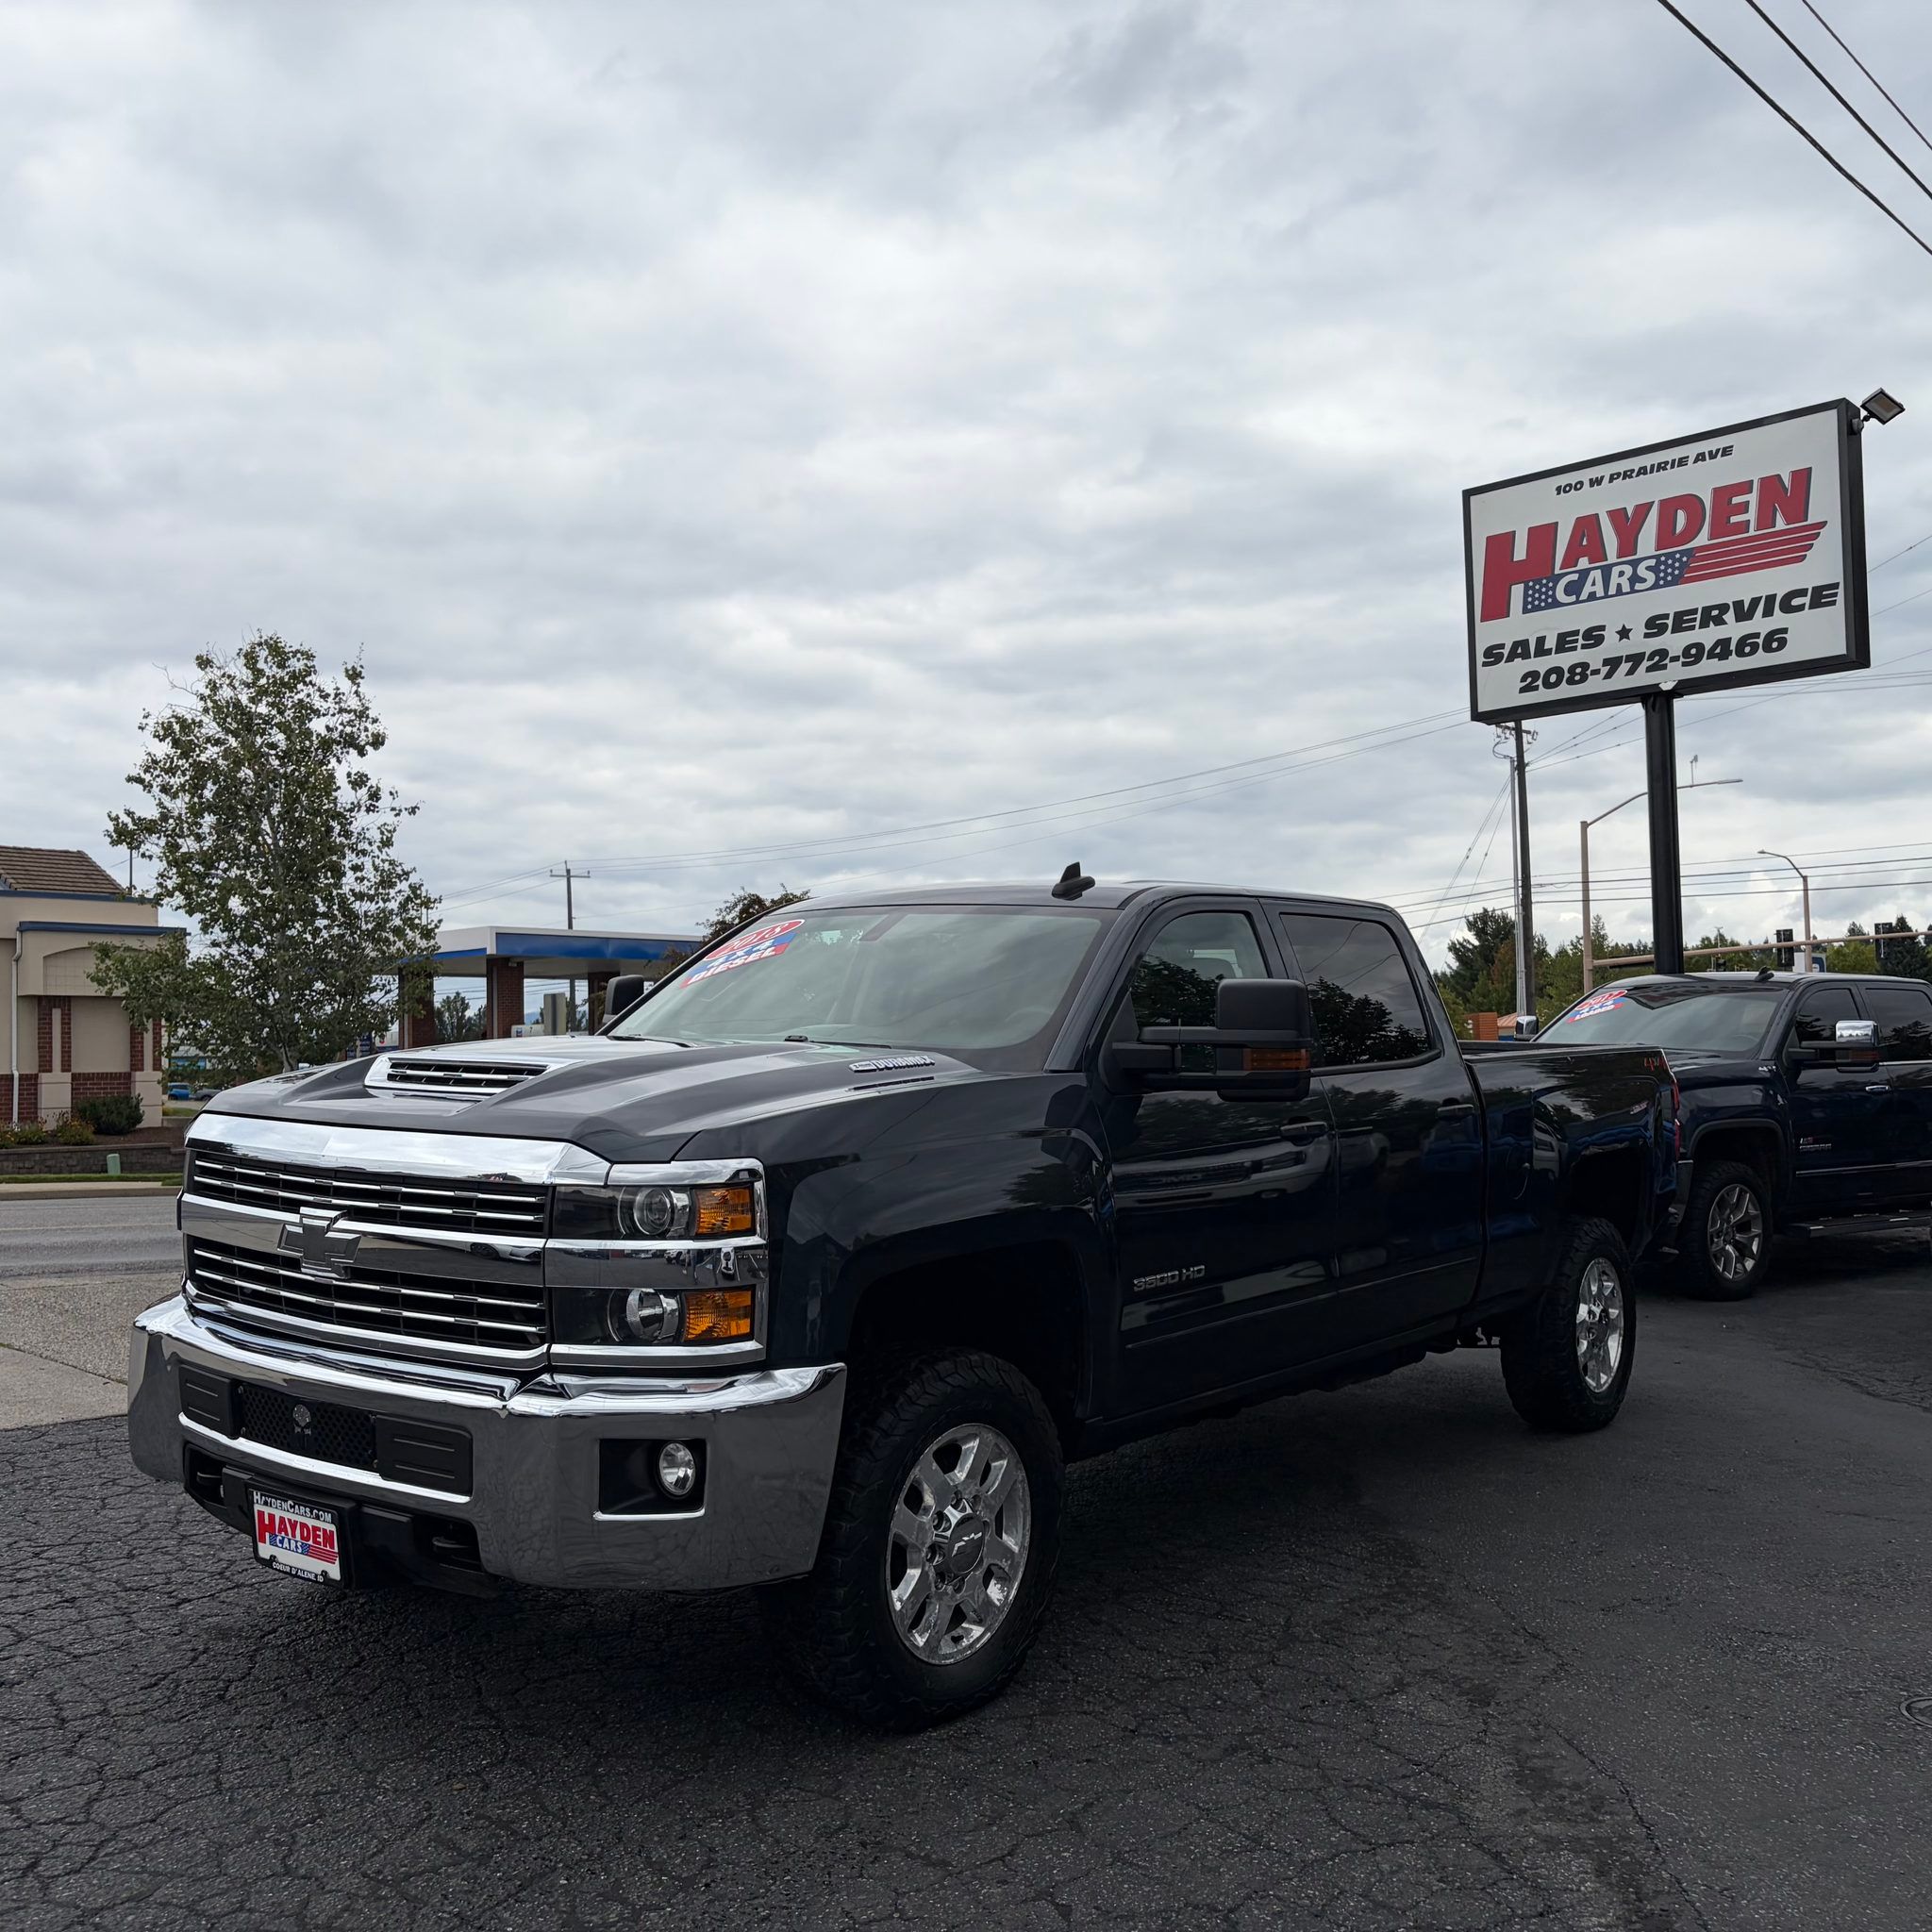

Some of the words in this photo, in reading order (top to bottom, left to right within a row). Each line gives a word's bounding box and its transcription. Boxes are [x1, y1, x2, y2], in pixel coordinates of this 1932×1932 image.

[1555, 480, 1584, 495] 100
[1589, 475, 1605, 488] W
[1608, 455, 1690, 484] PRAIRIE
[1692, 444, 1734, 464] AVE
[1480, 467, 1813, 623] HAYDEN
[1555, 553, 1657, 605] CARS
[1481, 625, 1607, 667] SALES
[1643, 582, 1840, 639] SERVICE
[1518, 627, 1789, 694] 208-772-9466
[715, 923, 789, 957] 2018
[687, 946, 775, 984] DIESEL
[871, 1055, 935, 1071] DURAMAX
[1181, 1265, 1206, 1281] HD
[257, 1508, 336, 1550] HAYDEN
[276, 1536, 303, 1553] CARS
[272, 1561, 291, 1574] COEUR
[317, 1574, 325, 1583] ID
